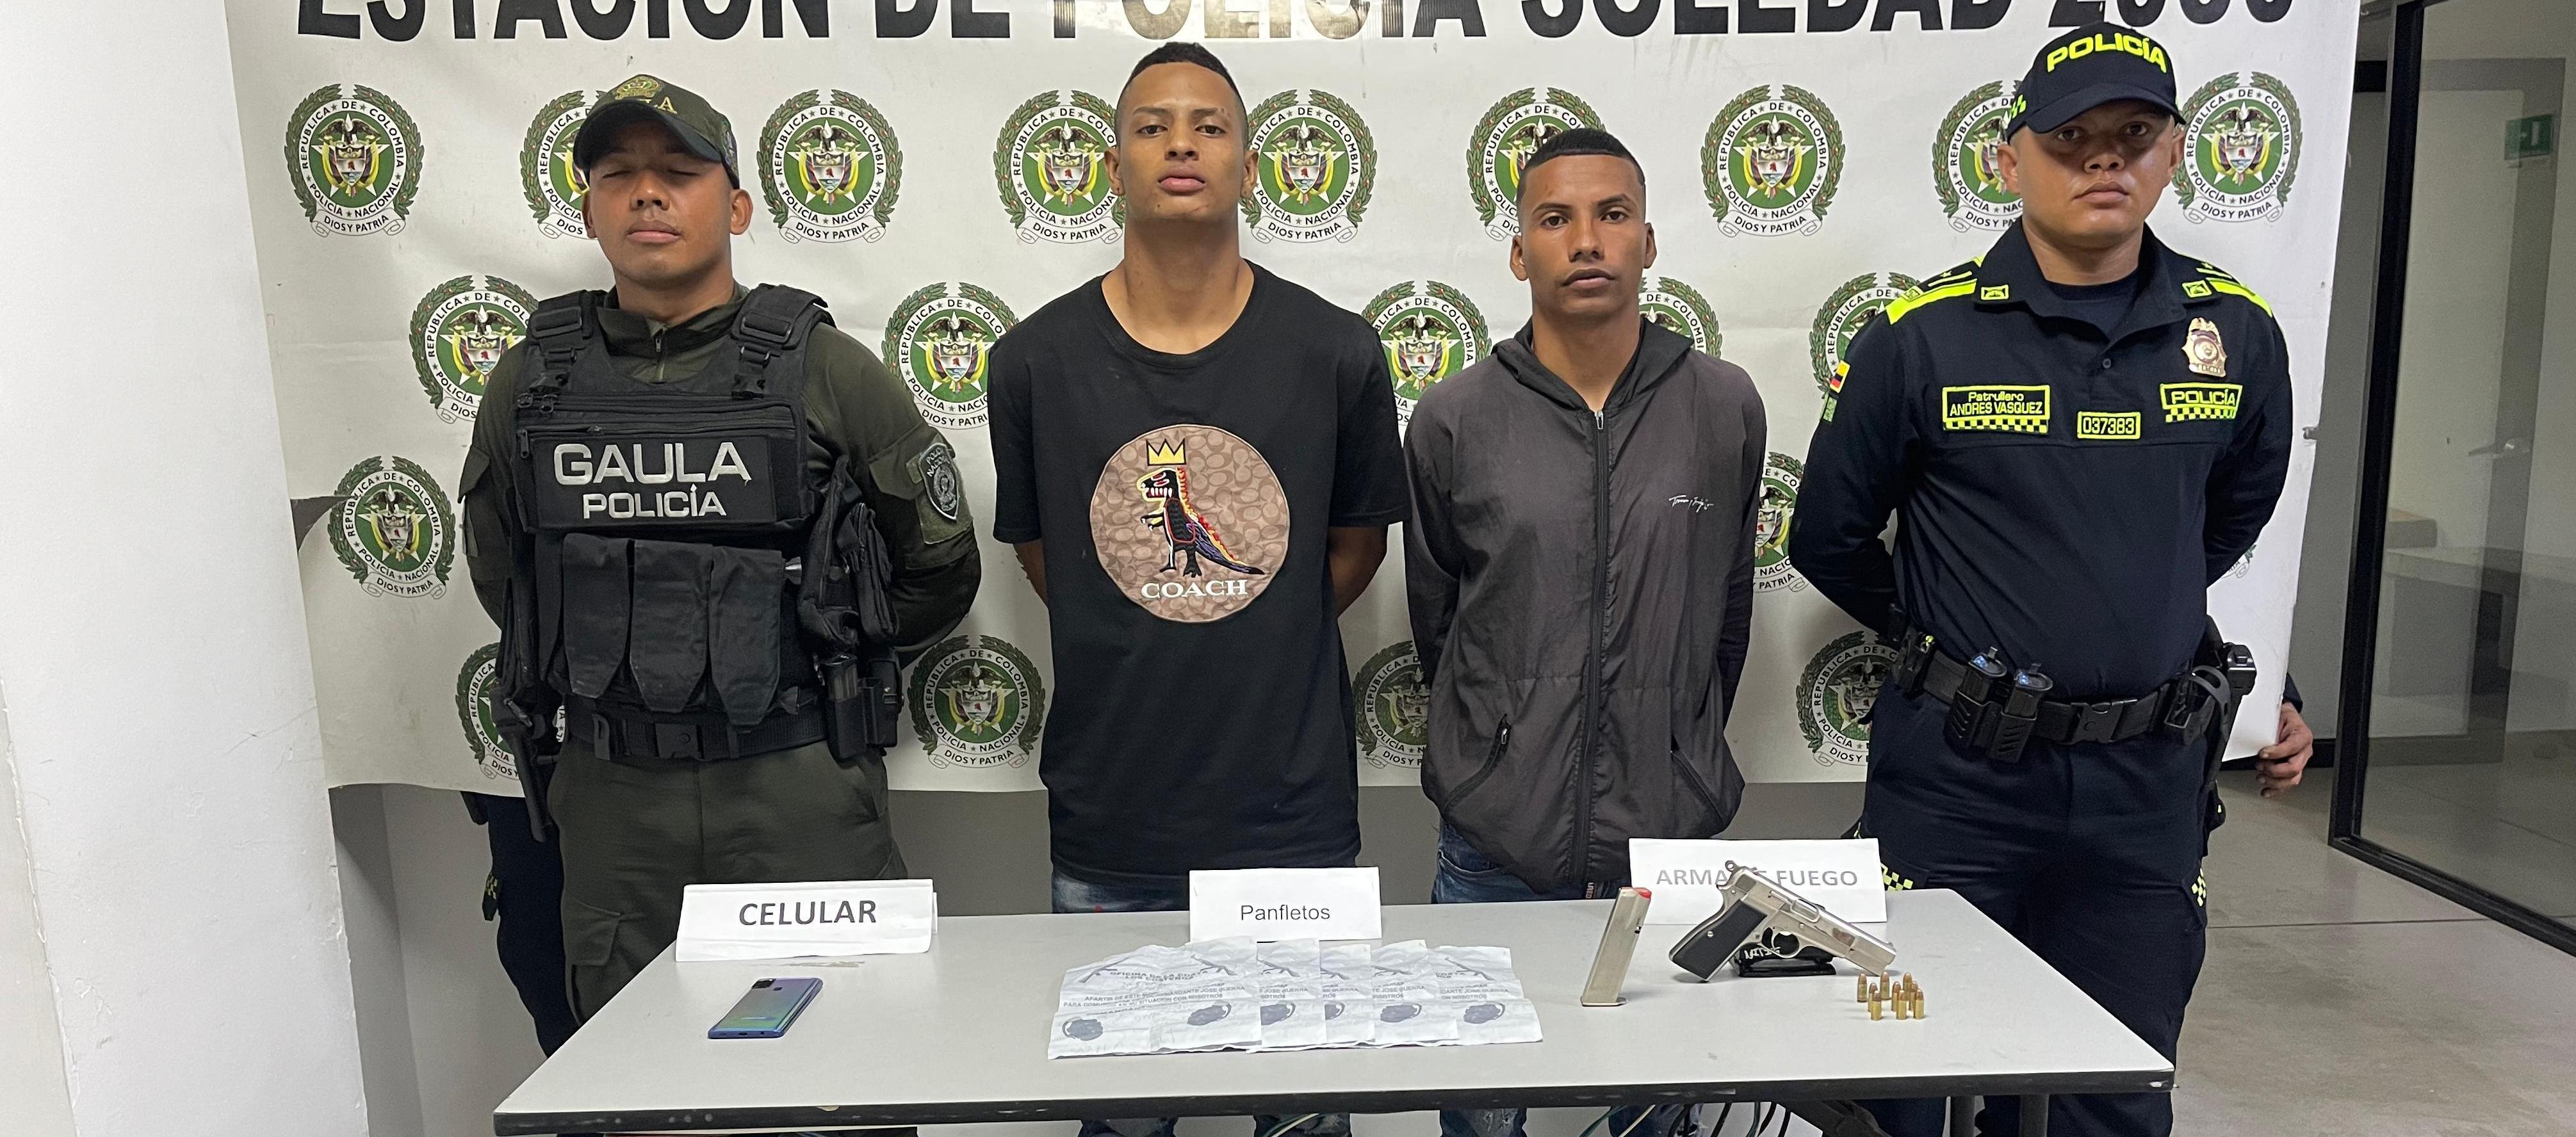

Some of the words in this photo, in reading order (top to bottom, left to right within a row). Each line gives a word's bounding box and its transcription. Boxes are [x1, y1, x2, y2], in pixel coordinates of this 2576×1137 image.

[2046, 32, 2167, 73] POLICÍA
[1535, 105, 1550, 114] DE
[2238, 89, 2254, 97] DE
[2264, 95, 2291, 156] COLOMBIA
[341, 101, 357, 109] DE
[370, 108, 405, 168] COLOMBIA
[1059, 108, 1075, 117] DE
[1087, 115, 1115, 144] COLO
[1769, 102, 1785, 111] DE
[1795, 109, 1827, 169] COLOMBIA
[820, 107, 836, 116] DE
[847, 114, 884, 175] COLOMBIA
[1298, 107, 1313, 116] DE
[1325, 114, 1359, 175] COLOMBIA
[354, 181, 400, 218] NACIONAL
[1771, 182, 1821, 219] NACIONAL
[2239, 169, 2285, 205] NACIONAL
[832, 189, 881, 225] NACIONAL
[1070, 195, 1116, 226] NACIONA
[1305, 189, 1354, 225] NACIONAL
[1490, 187, 1517, 216] POLIC
[2238, 202, 2272, 219] PATRIA
[355, 214, 389, 232] PATRIA
[832, 222, 869, 239] PATRIA
[1070, 223, 1107, 240] PATRIA
[1305, 222, 1342, 239] PATRIA
[1770, 216, 1807, 233] PATRIA
[474, 292, 491, 301] DE
[1876, 289, 1892, 297] DE
[947, 299, 963, 308] DE
[975, 306, 1002, 334] COLO
[1415, 298, 1430, 306] DE
[1441, 304, 1474, 362] COLOMBIA
[1646, 294, 1661, 302] DE
[1672, 300, 1704, 348] COLOMBI
[958, 394, 991, 412] NACIO
[1950, 402, 1993, 416] ANDRES
[1994, 401, 2042, 414] VASQUEZ
[1968, 391, 2024, 402] Patrullero
[2171, 389, 2235, 405] POLICÍA
[958, 413, 988, 426] PATRI
[2083, 417, 2135, 434] 037383
[553, 442, 752, 487] GAULA
[384, 472, 396, 481] DE
[406, 480, 440, 536] COLOMBIA
[583, 484, 726, 519] POLICÍA
[404, 549, 439, 581] NACIONAL
[1759, 558, 1792, 576] NACIO
[407, 580, 434, 594] PATRIA
[1141, 579, 1248, 600] COACH
[1759, 573, 1795, 590] PATRIA
[969, 650, 984, 658] DE
[995, 656, 1029, 709] COLOMBIA
[979, 721, 1025, 752] NACIONAL
[979, 750, 1014, 765] PATRIA
[1656, 869, 1728, 886] ARMA
[1777, 870, 1857, 886] FUEGO
[739, 899, 876, 926] CELULAR
[1241, 904, 1330, 921] Panfletos
